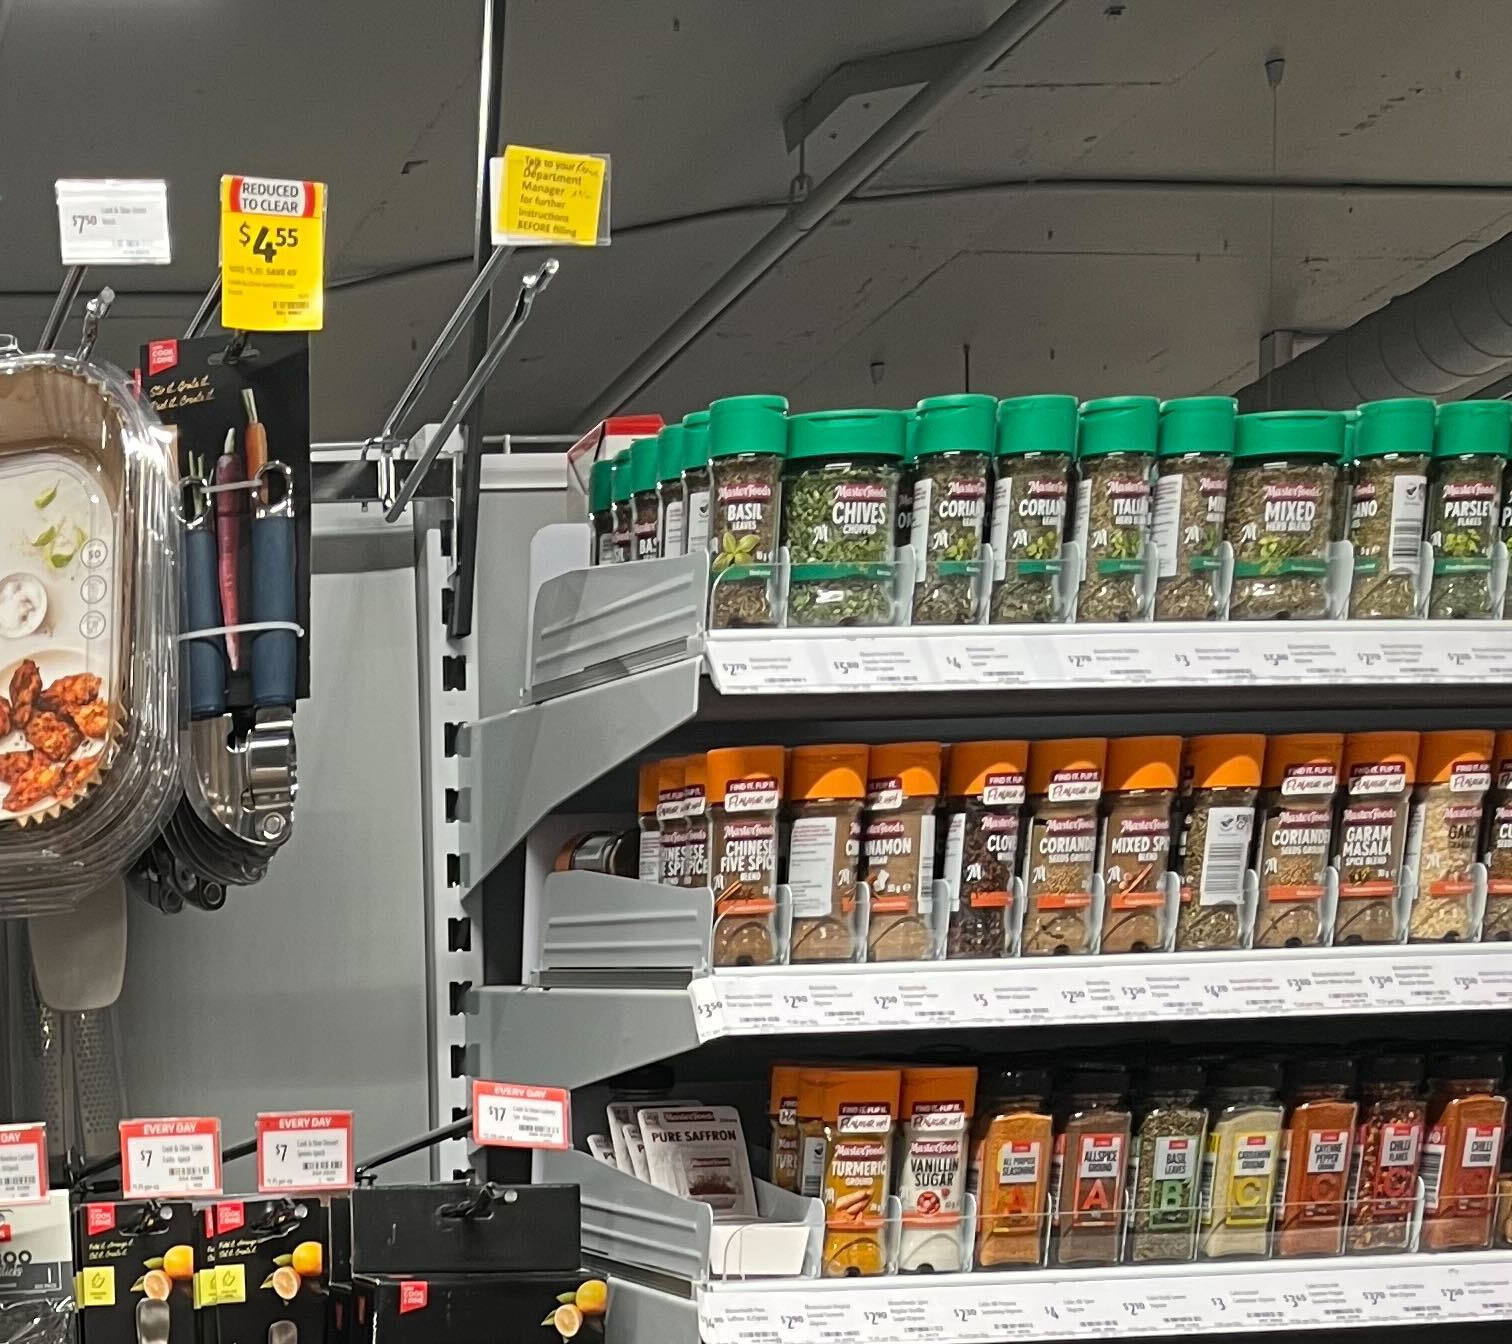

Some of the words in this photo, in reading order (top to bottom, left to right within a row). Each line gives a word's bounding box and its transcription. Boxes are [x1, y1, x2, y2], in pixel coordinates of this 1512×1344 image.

[242, 182, 299, 199] REDUCED
[242, 197, 258, 212] TO
[261, 198, 299, 213] CLEAR
[727, 503, 763, 522] BASIL
[832, 501, 886, 525] CHIVES
[1264, 500, 1316, 523] MIXED
[1346, 827, 1392, 842] GARAM
[1111, 837, 1150, 854] MIXED
[1342, 840, 1392, 858] MASALA
[720, 855, 745, 873] FIVE
[652, 1131, 682, 1144] PURE
[685, 1130, 737, 1142] SAFFRON
[140, 1148, 153, 1168] $7
[910, 1158, 959, 1173] VANILLIN
[914, 1171, 954, 1188] SUGAR
